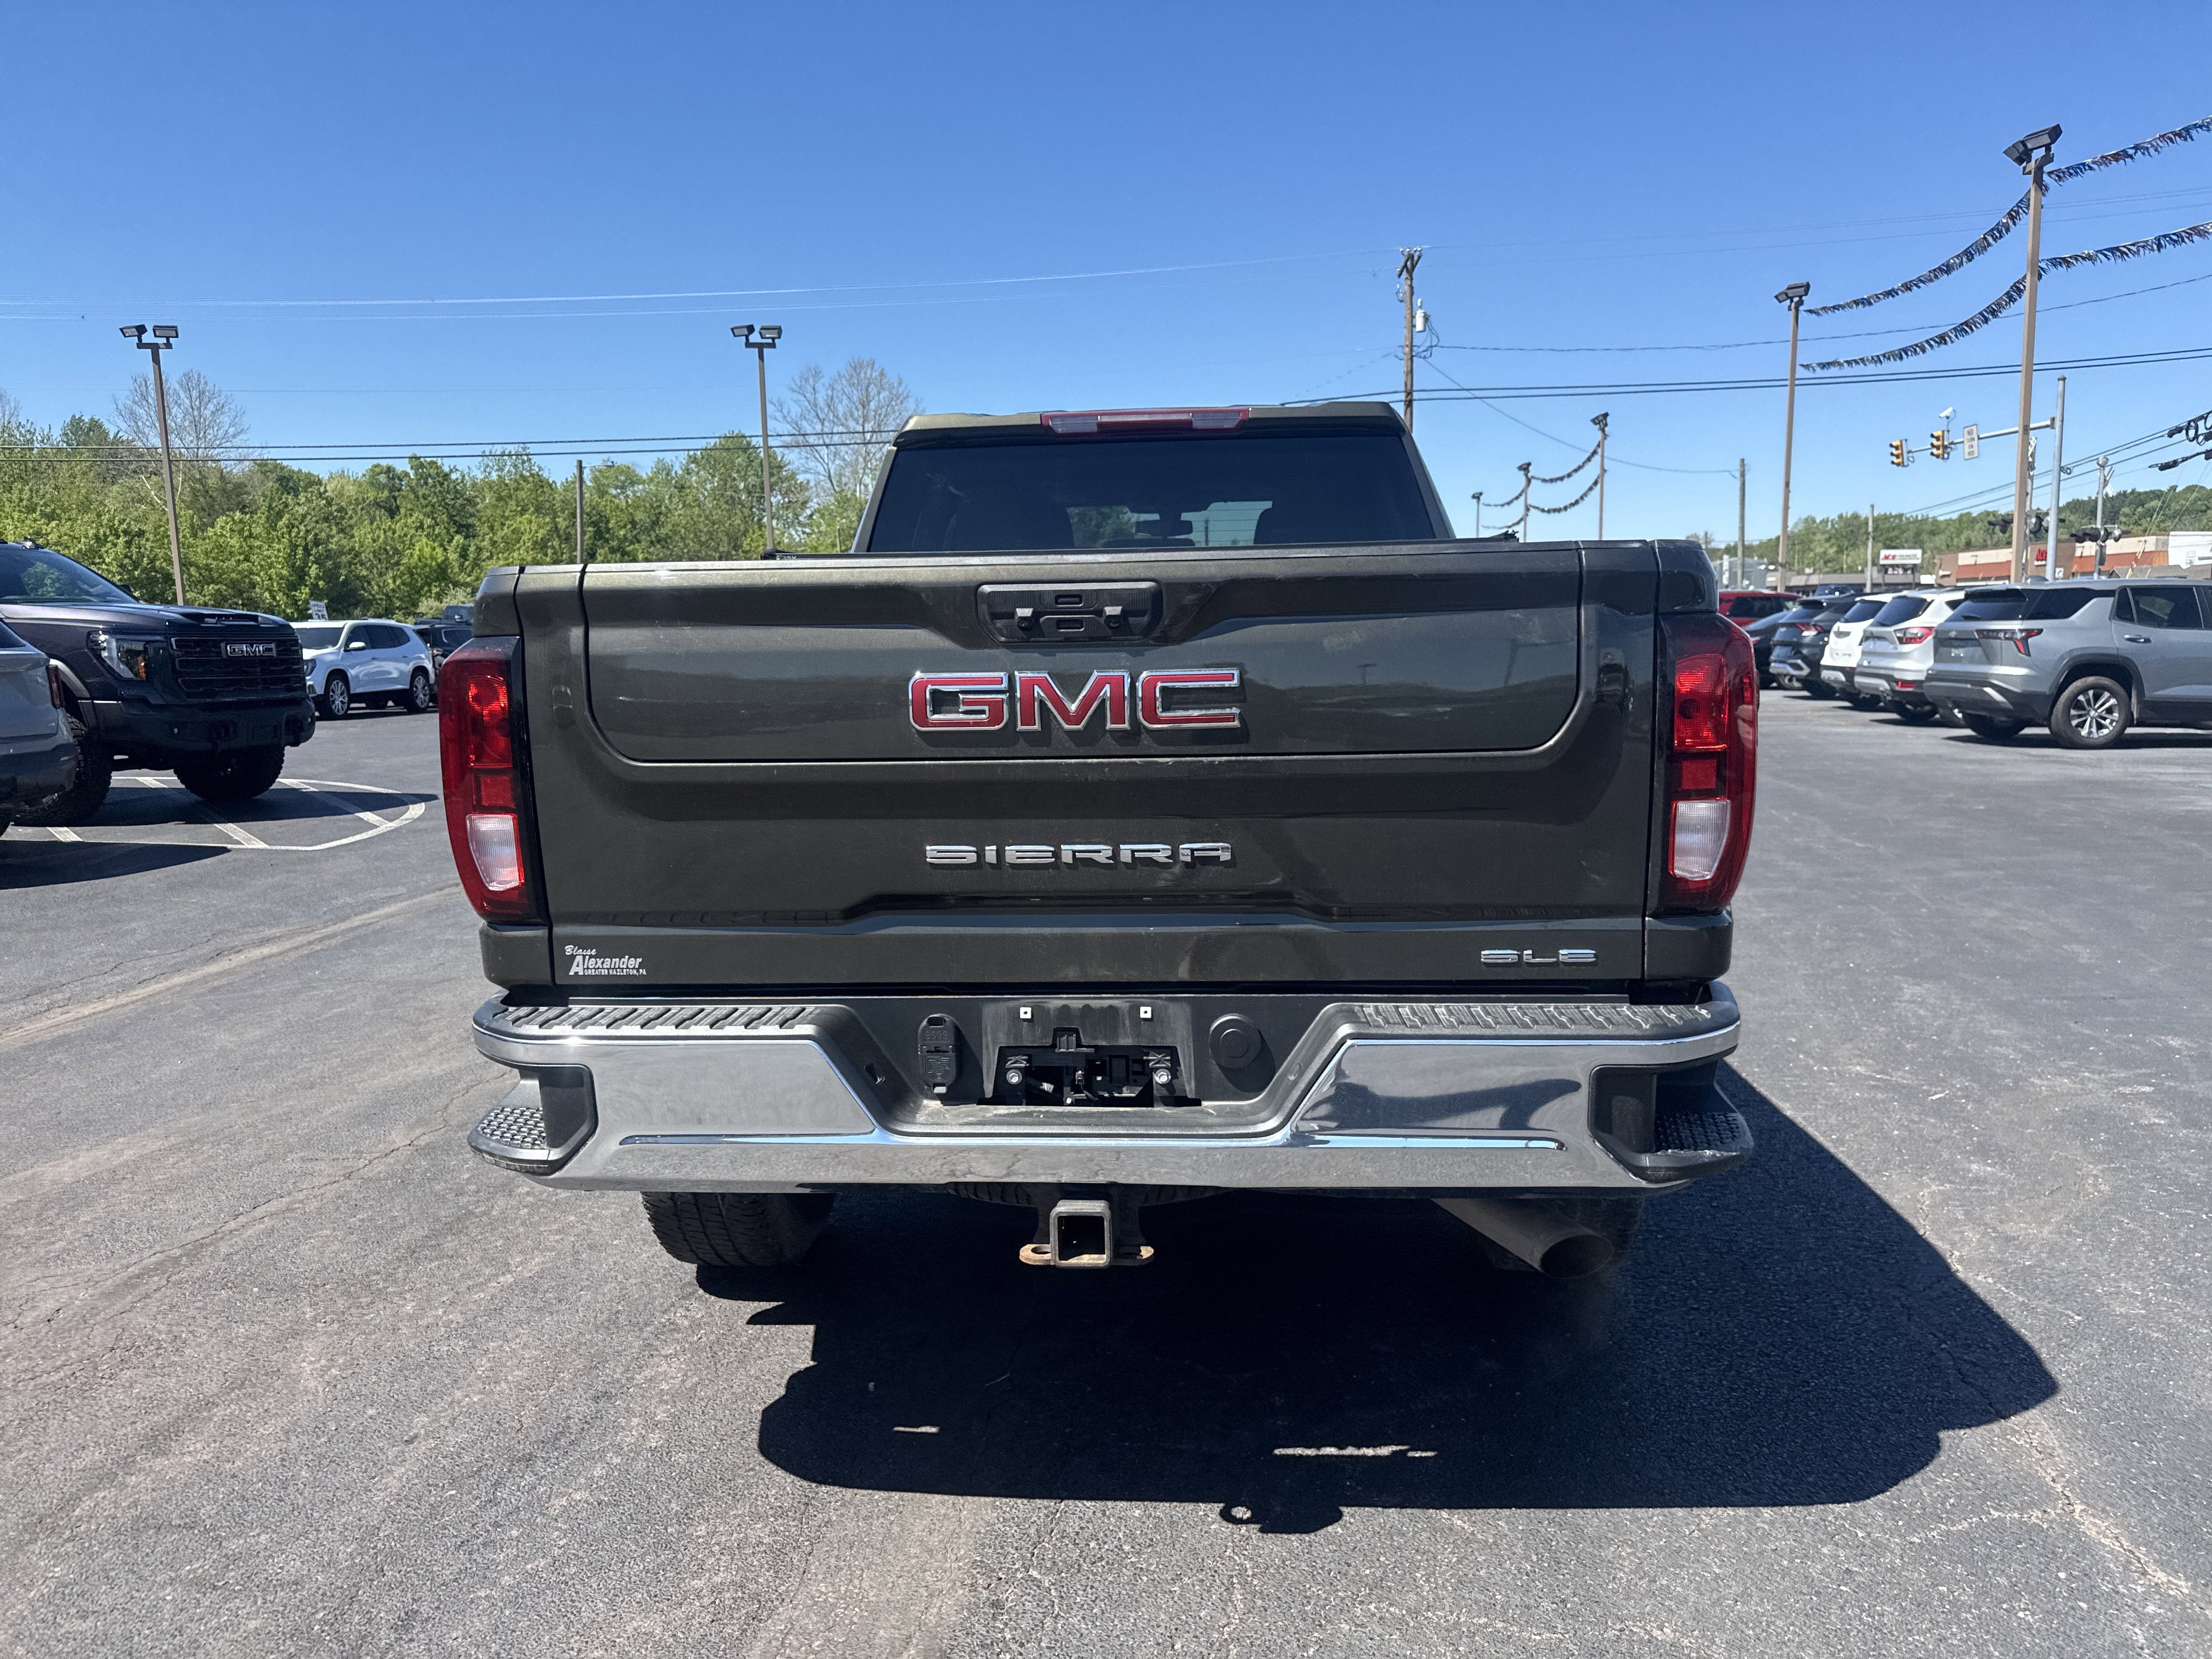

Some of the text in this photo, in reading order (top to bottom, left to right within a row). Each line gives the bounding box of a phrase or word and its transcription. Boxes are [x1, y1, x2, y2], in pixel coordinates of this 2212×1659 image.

[227, 644, 276, 657] GMC
[909, 668, 1241, 732] GMC
[926, 842, 1232, 865] SIERRA
[564, 945, 597, 955] Blaise
[1481, 949, 1596, 963] SLE
[568, 955, 642, 975] Alexander
